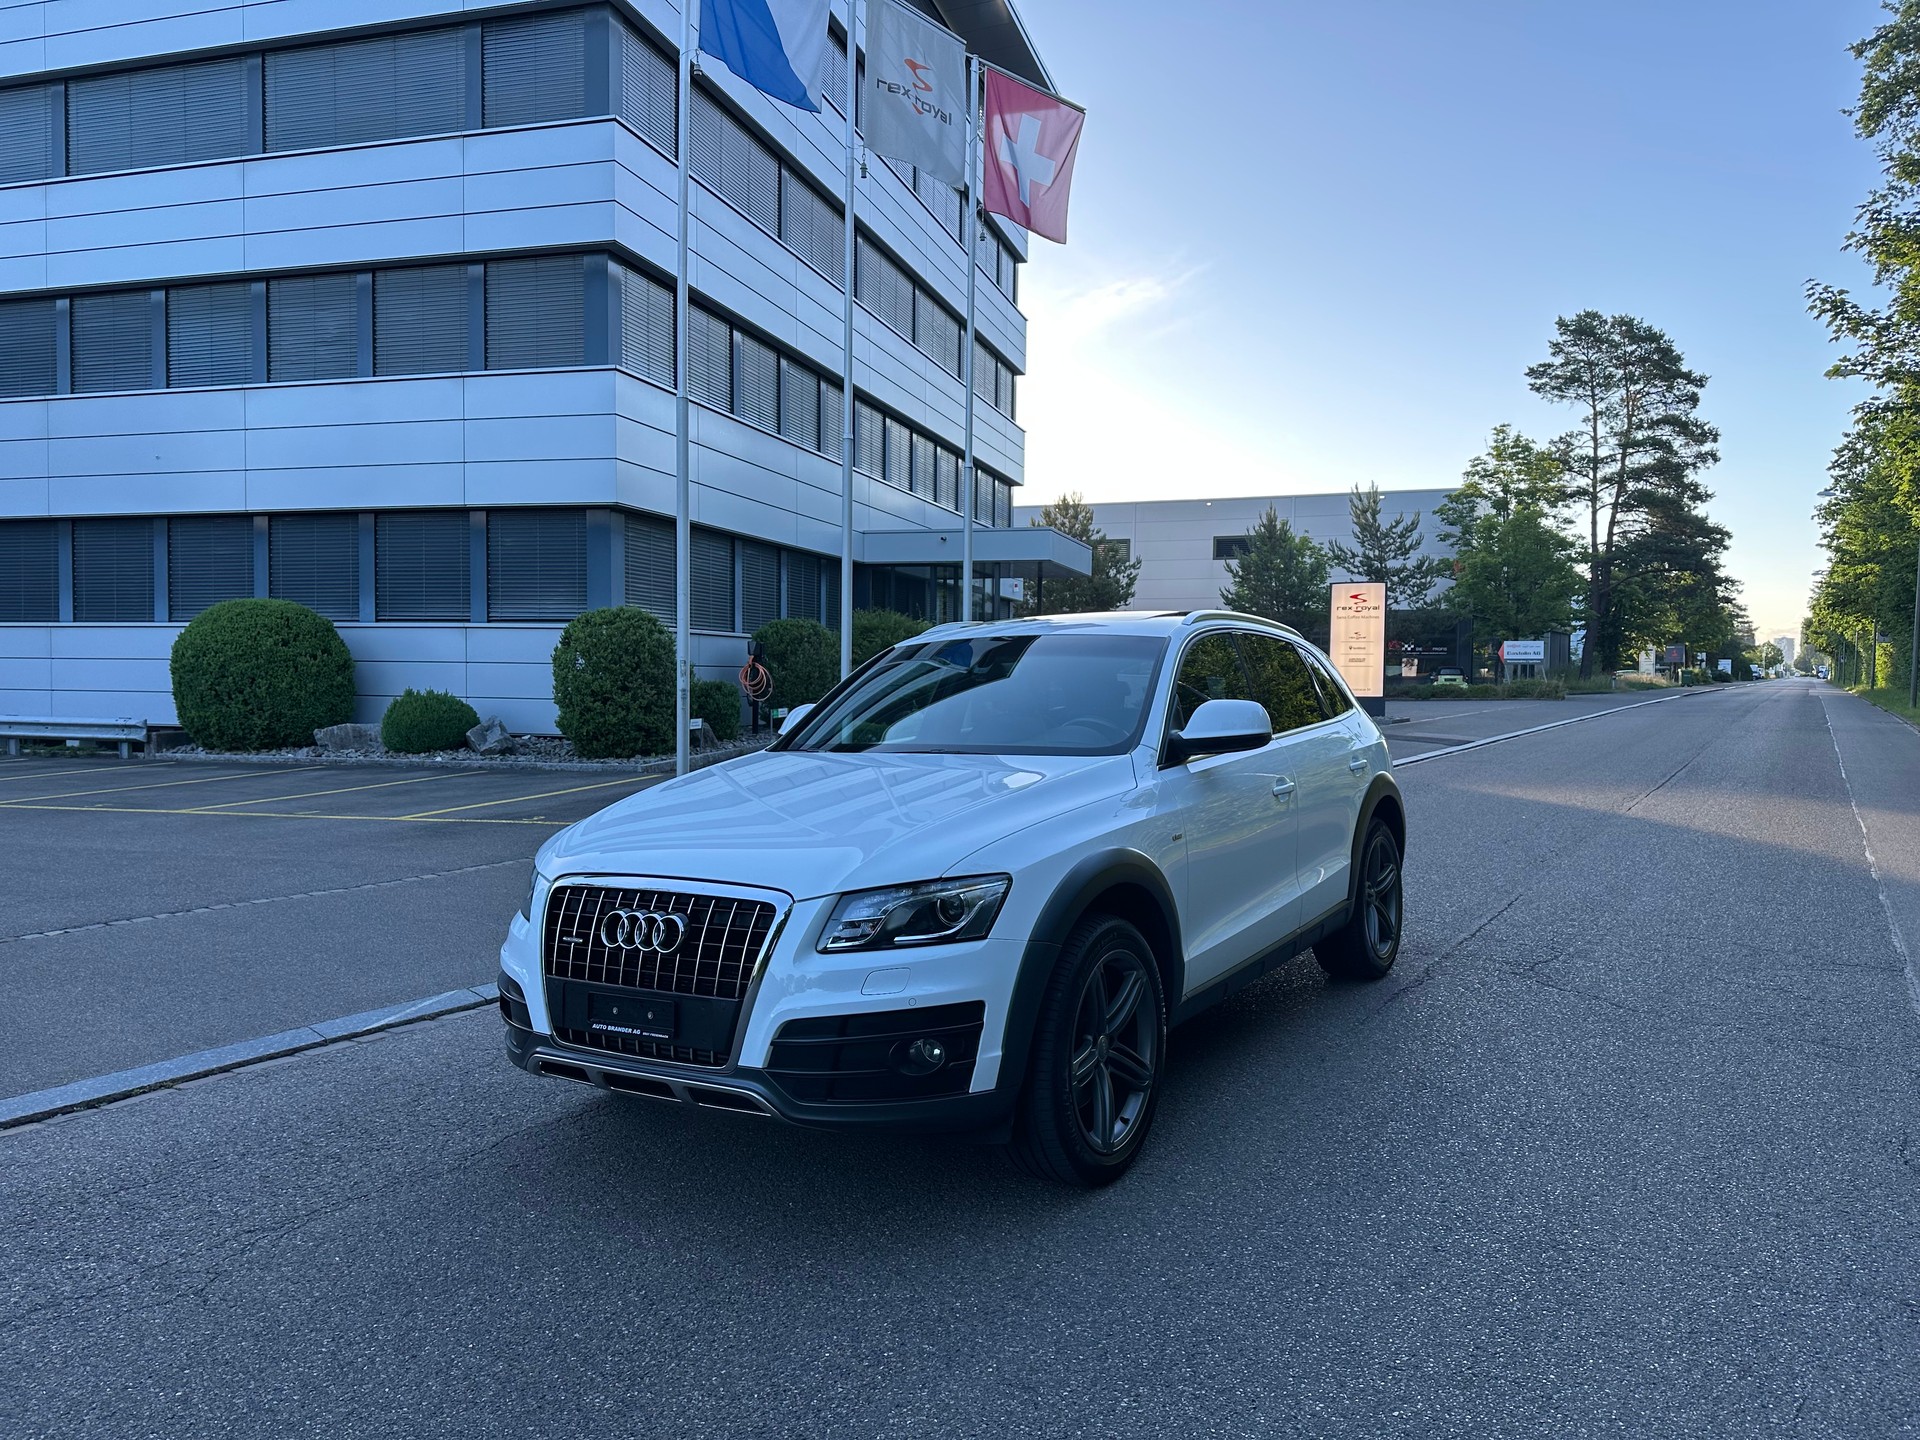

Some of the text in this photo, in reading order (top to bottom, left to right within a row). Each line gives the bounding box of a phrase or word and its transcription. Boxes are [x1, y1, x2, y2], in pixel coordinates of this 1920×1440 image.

[876, 77, 952, 126] rex royal
[607, 1025, 632, 1034] BRANDER
